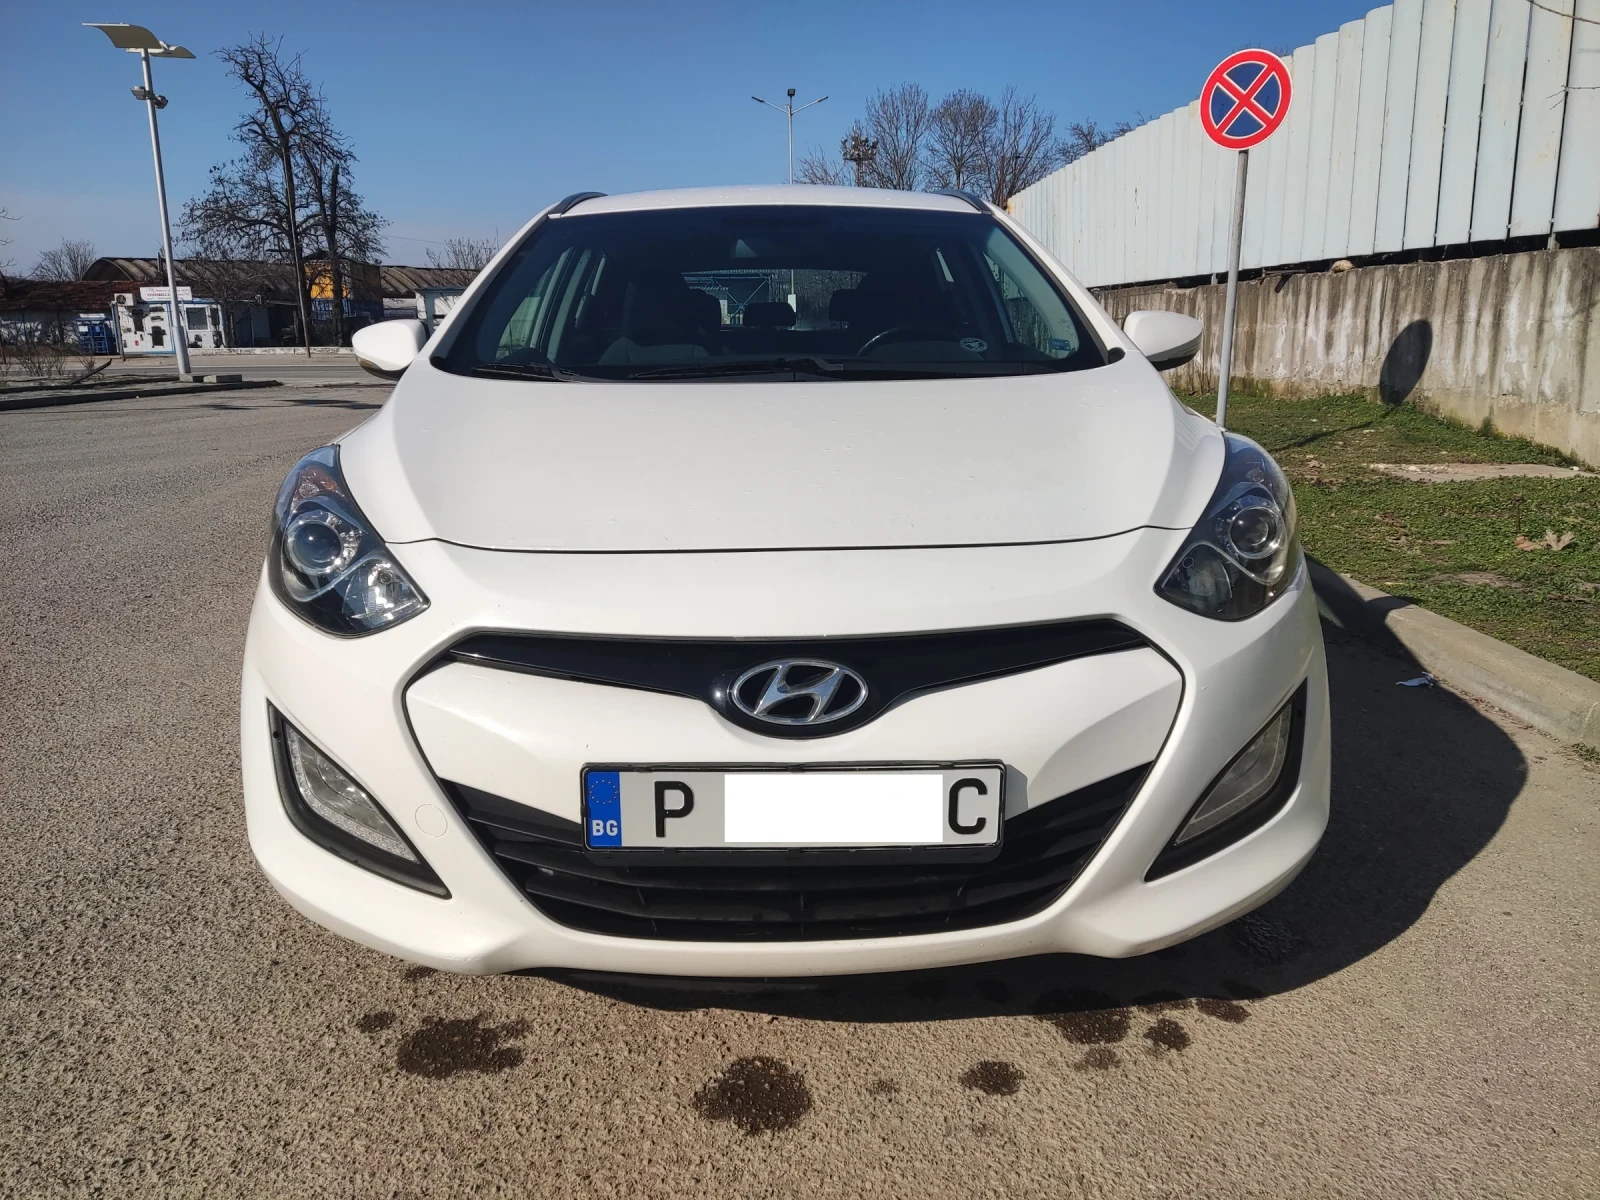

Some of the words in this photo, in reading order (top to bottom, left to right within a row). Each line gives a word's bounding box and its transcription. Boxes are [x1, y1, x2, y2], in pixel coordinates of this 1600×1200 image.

[654, 780, 695, 838] P
[948, 778, 988, 835] C
[592, 819, 618, 837] BG
